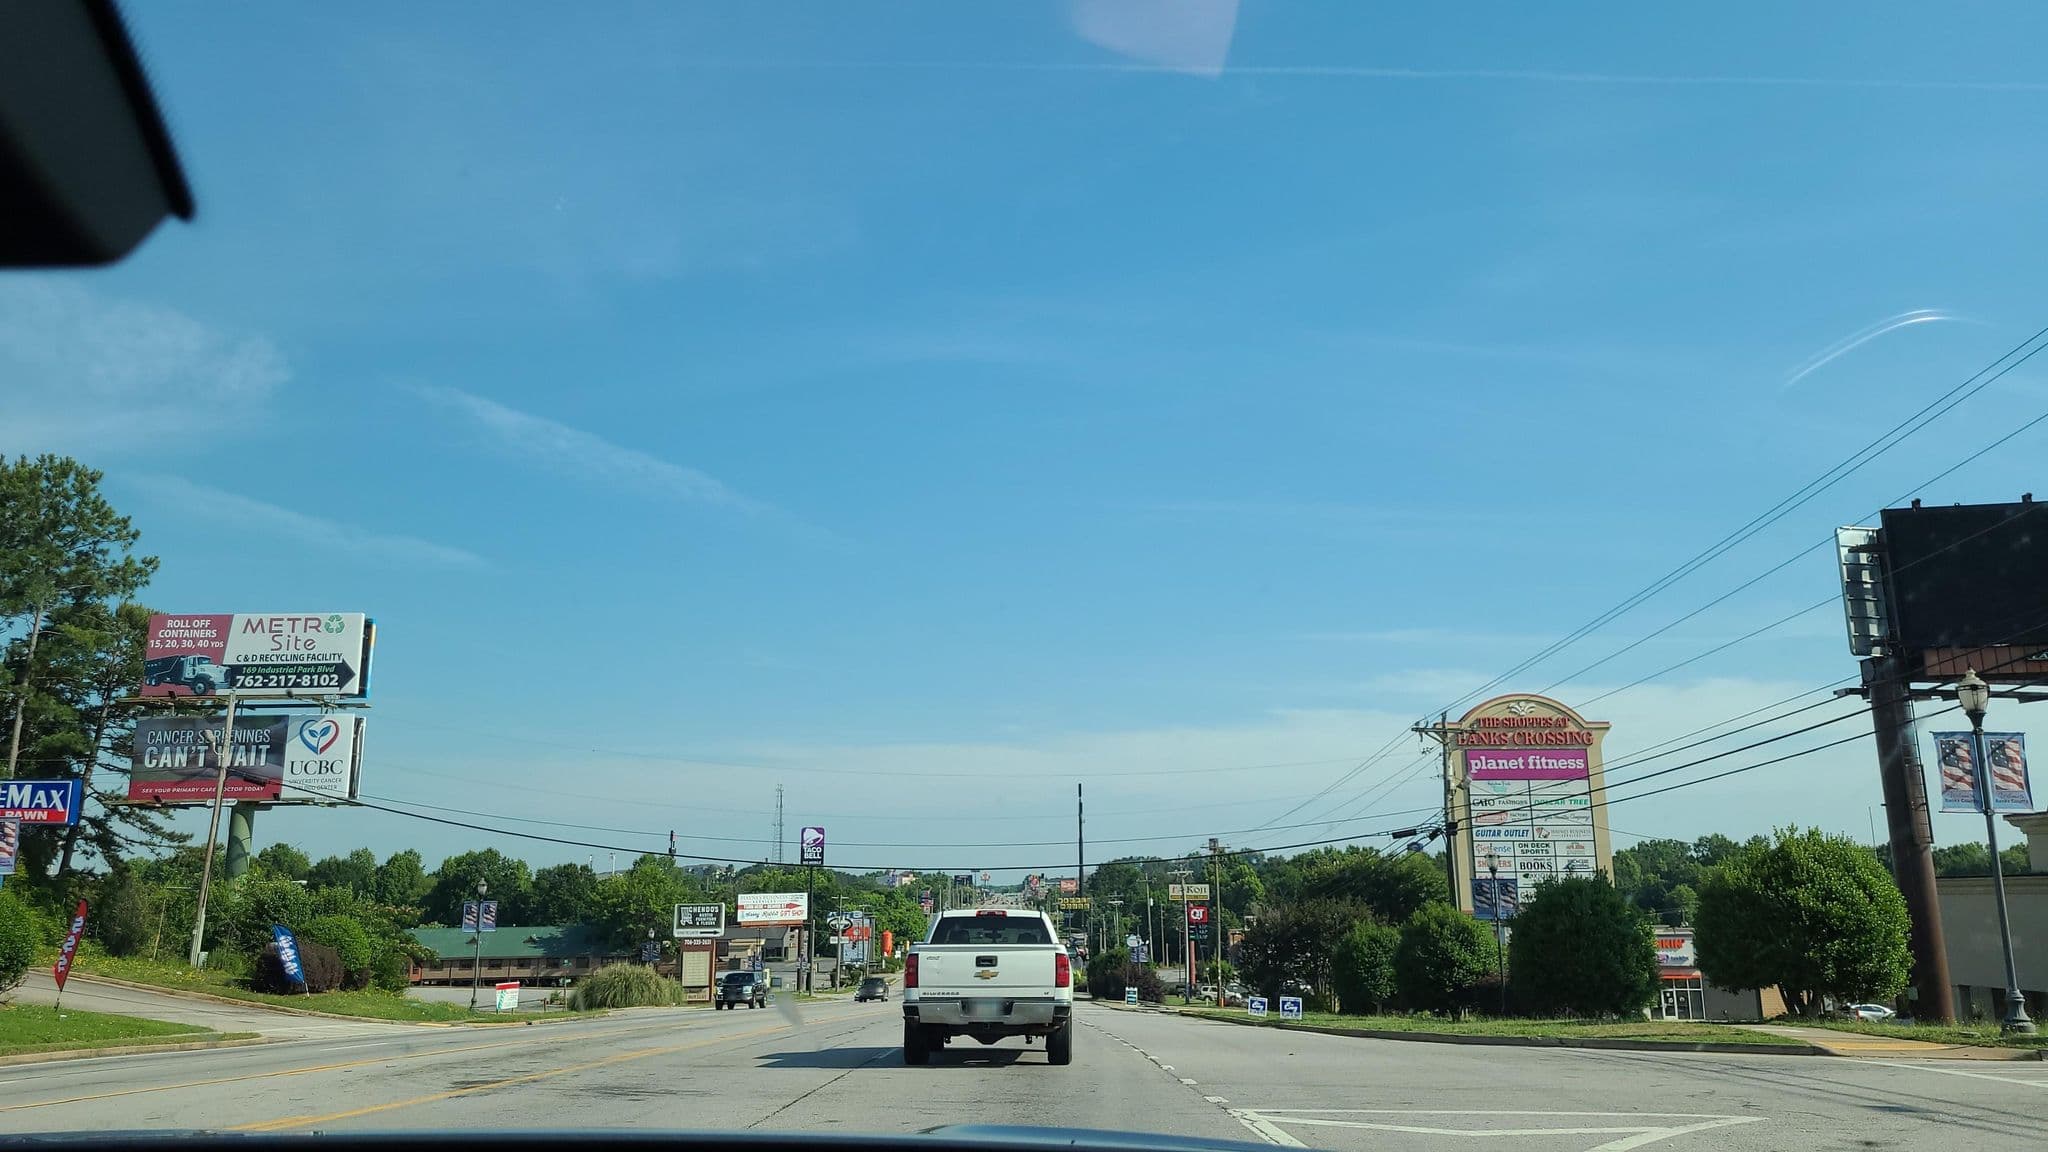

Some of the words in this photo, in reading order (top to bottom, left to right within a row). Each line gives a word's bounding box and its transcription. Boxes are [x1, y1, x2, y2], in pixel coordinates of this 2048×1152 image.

[167, 620, 190, 628] ROLL
[192, 620, 210, 628] OFF
[158, 629, 217, 638] CONTAINERS
[150, 640, 163, 648] 15,
[165, 640, 179, 648] 20,
[181, 640, 196, 648] 30,
[197, 640, 208, 648] 40
[270, 634, 316, 651] Site
[236, 654, 242, 662] C
[244, 654, 250, 662] &
[260, 653, 304, 662] RECYCLING
[306, 653, 342, 661] FACILITY
[318, 665, 335, 673] Blvd
[236, 674, 339, 687] 762-217-8102
[1478, 717, 1500, 728] THE
[1503, 717, 1552, 728] SHOPPES
[1556, 717, 1570, 728] AT
[147, 730, 194, 744] CANCER
[1513, 730, 1594, 746] CROSSING
[144, 745, 208, 768] CAN'T
[290, 760, 344, 775] UCBC
[1470, 756, 1524, 773] planet
[1528, 756, 1585, 769] fitness
[1504, 829, 1529, 837] OUTLET
[1520, 862, 1553, 870] BOOKS
[1190, 908, 1204, 920] QT
